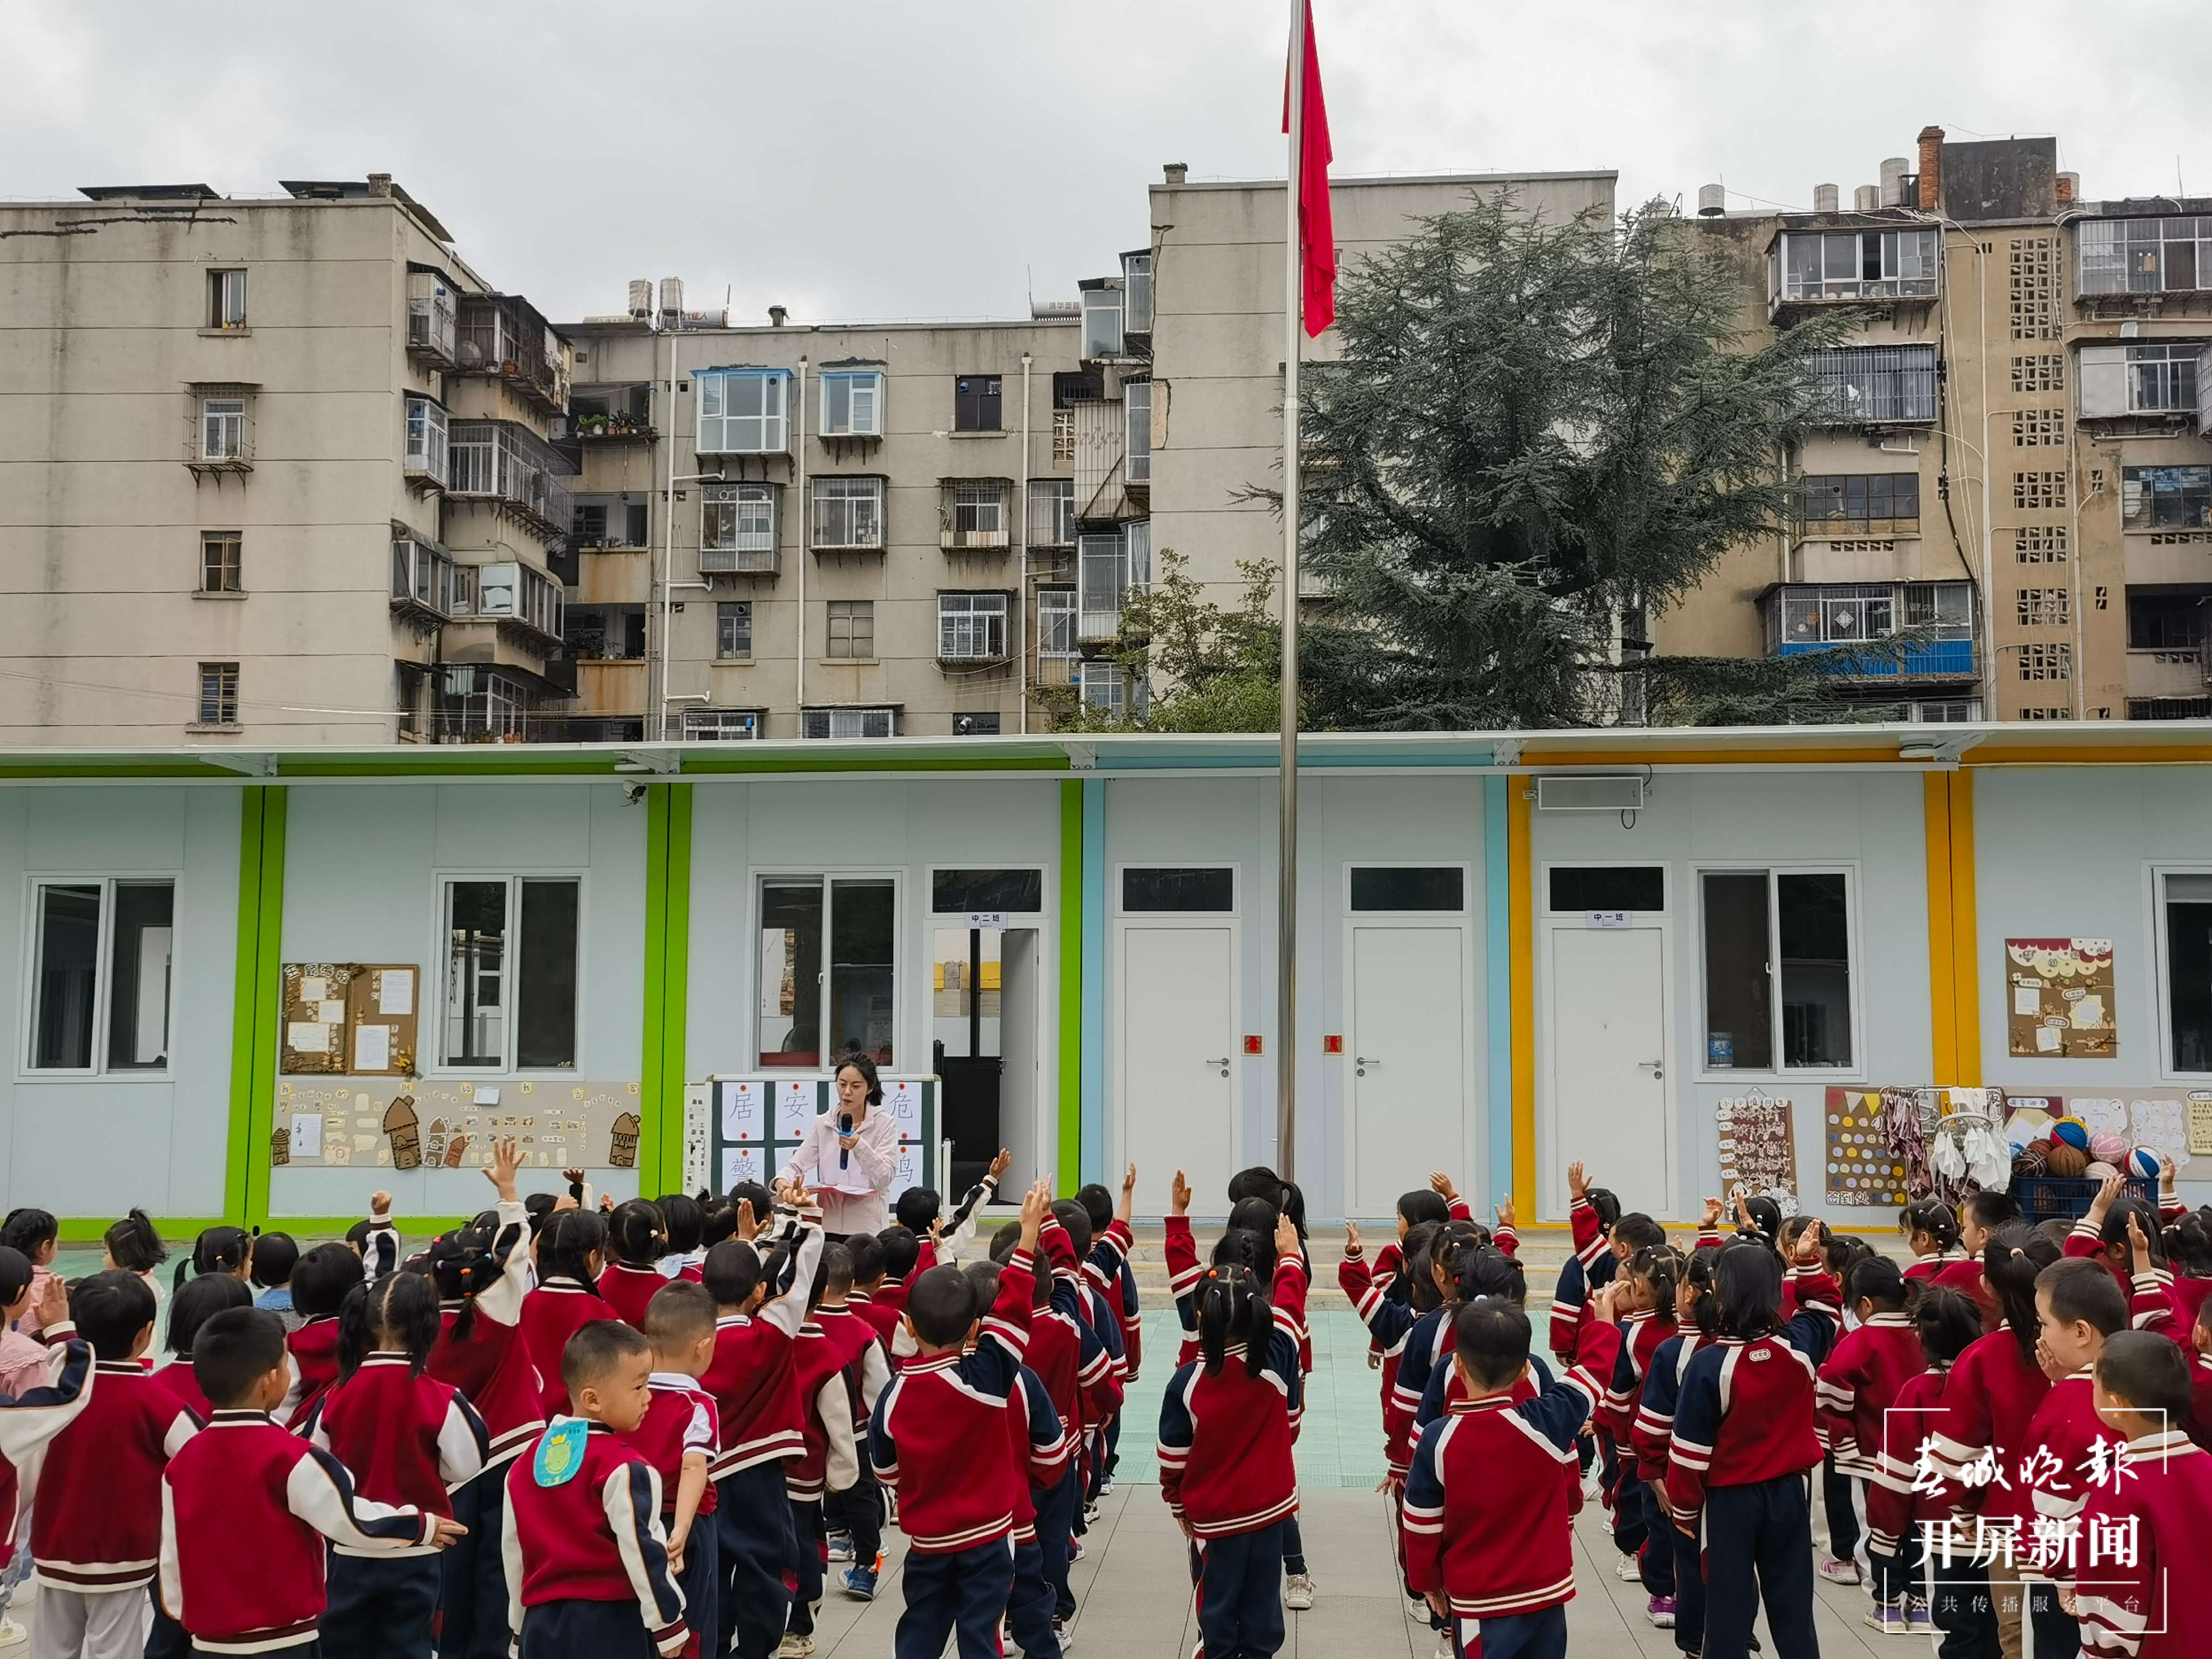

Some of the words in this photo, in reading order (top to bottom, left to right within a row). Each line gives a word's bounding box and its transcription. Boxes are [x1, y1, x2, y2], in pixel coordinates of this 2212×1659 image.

[972, 914, 1000, 922] 中二班
[1594, 913, 1623, 921] 中一班
[1724, 1097, 1784, 1107] 小小值日生
[1826, 1191, 1870, 1205] 签到处
